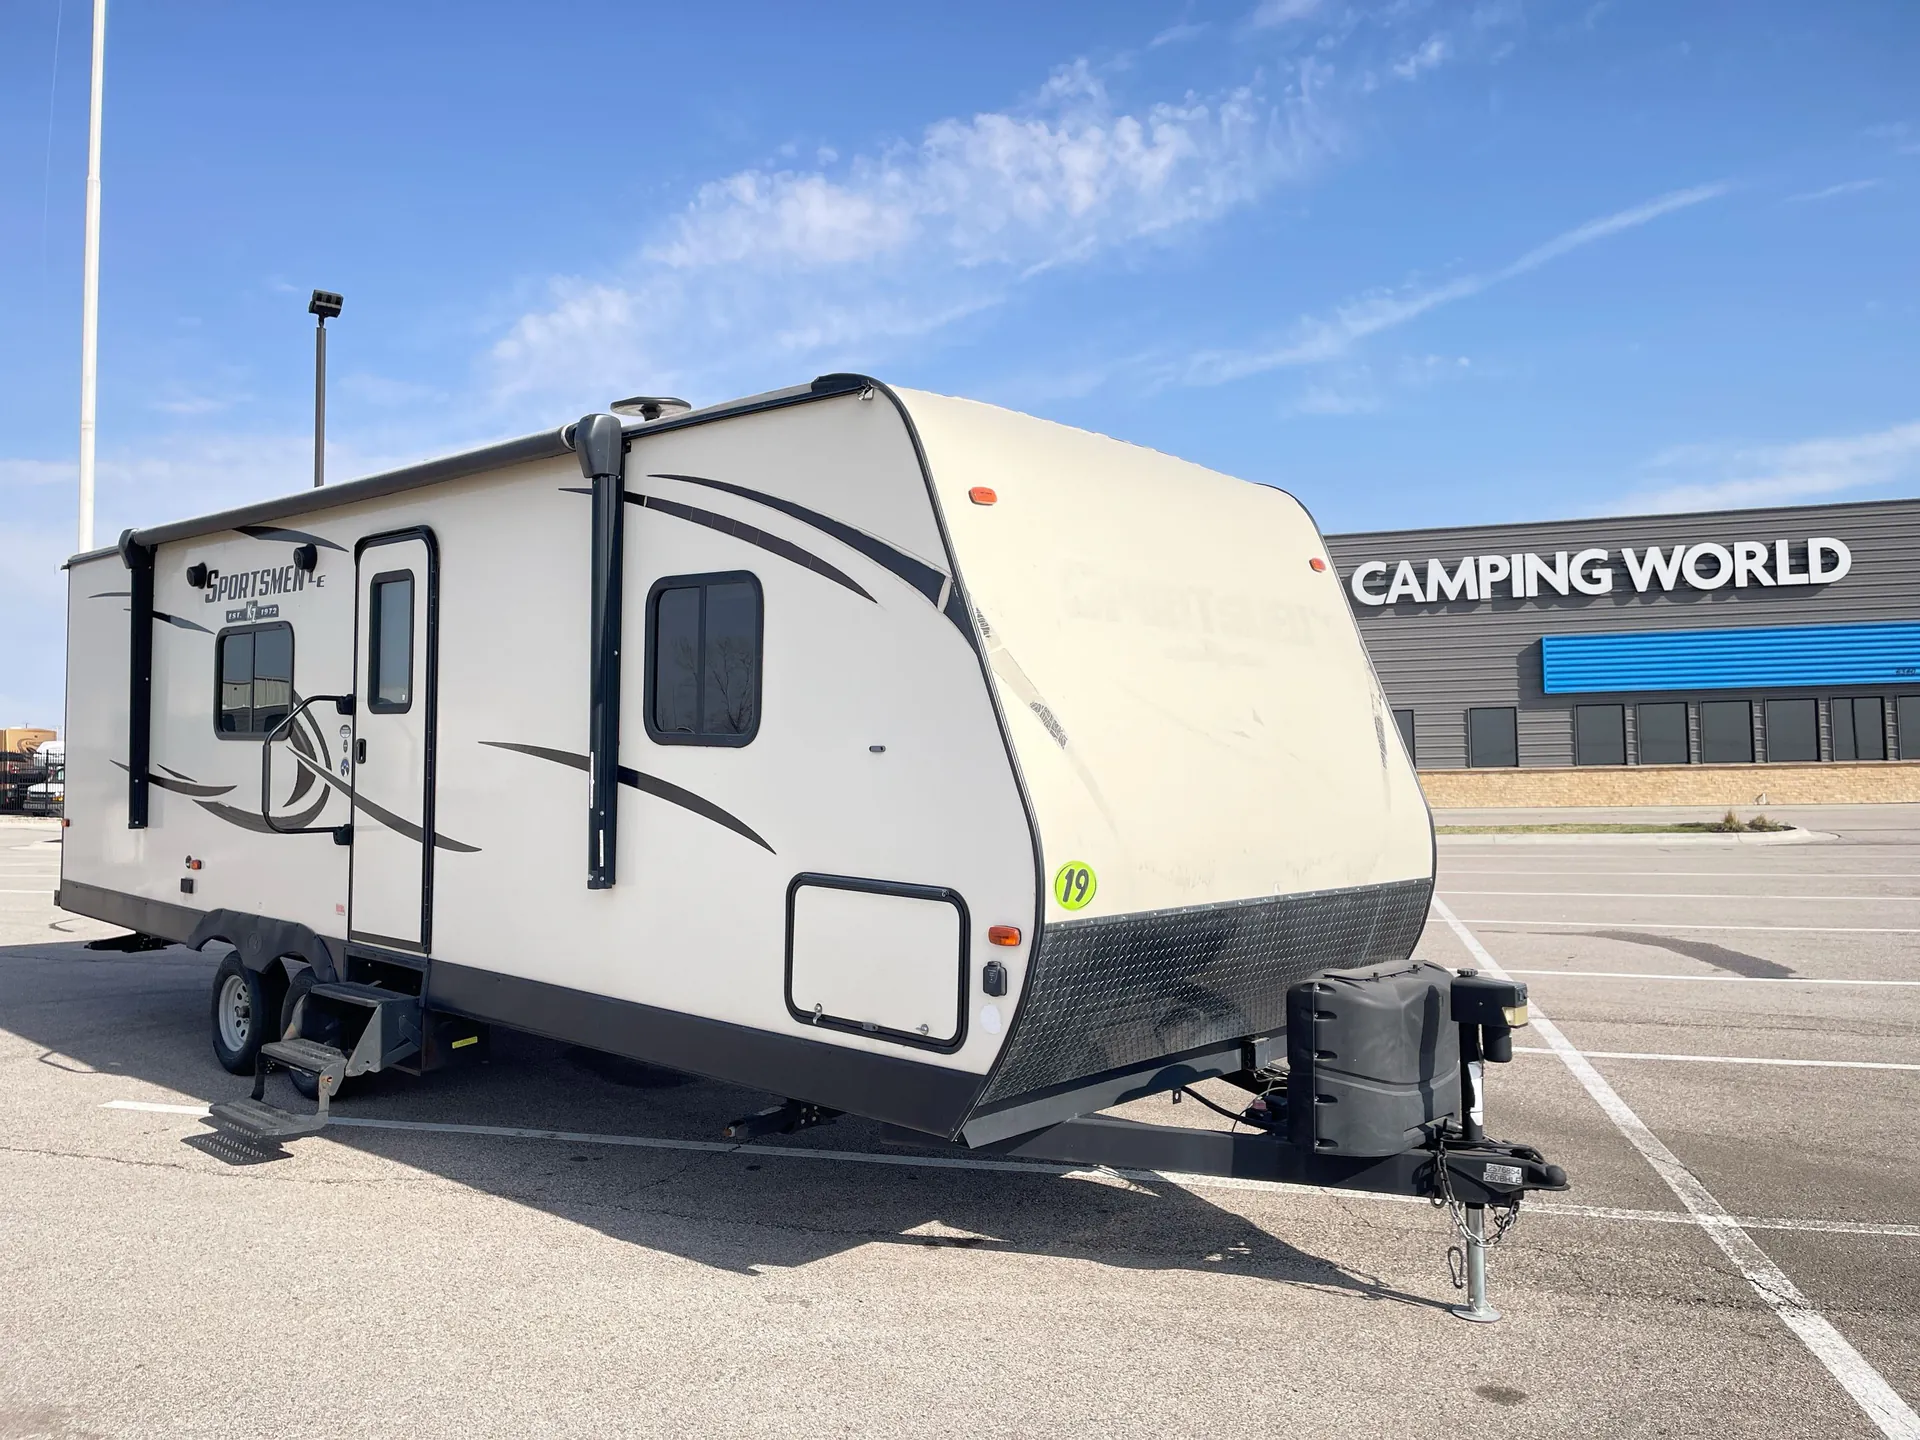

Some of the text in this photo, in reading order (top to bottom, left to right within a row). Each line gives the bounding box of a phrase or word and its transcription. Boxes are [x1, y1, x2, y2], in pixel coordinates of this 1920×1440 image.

[205, 565, 305, 603] SPORTSMEN
[1351, 547, 1613, 606] CAMPING
[1621, 537, 1852, 593] WORLD
[228, 612, 242, 620] EST.
[260, 607, 277, 616] 1972
[1062, 868, 1090, 903] 19
